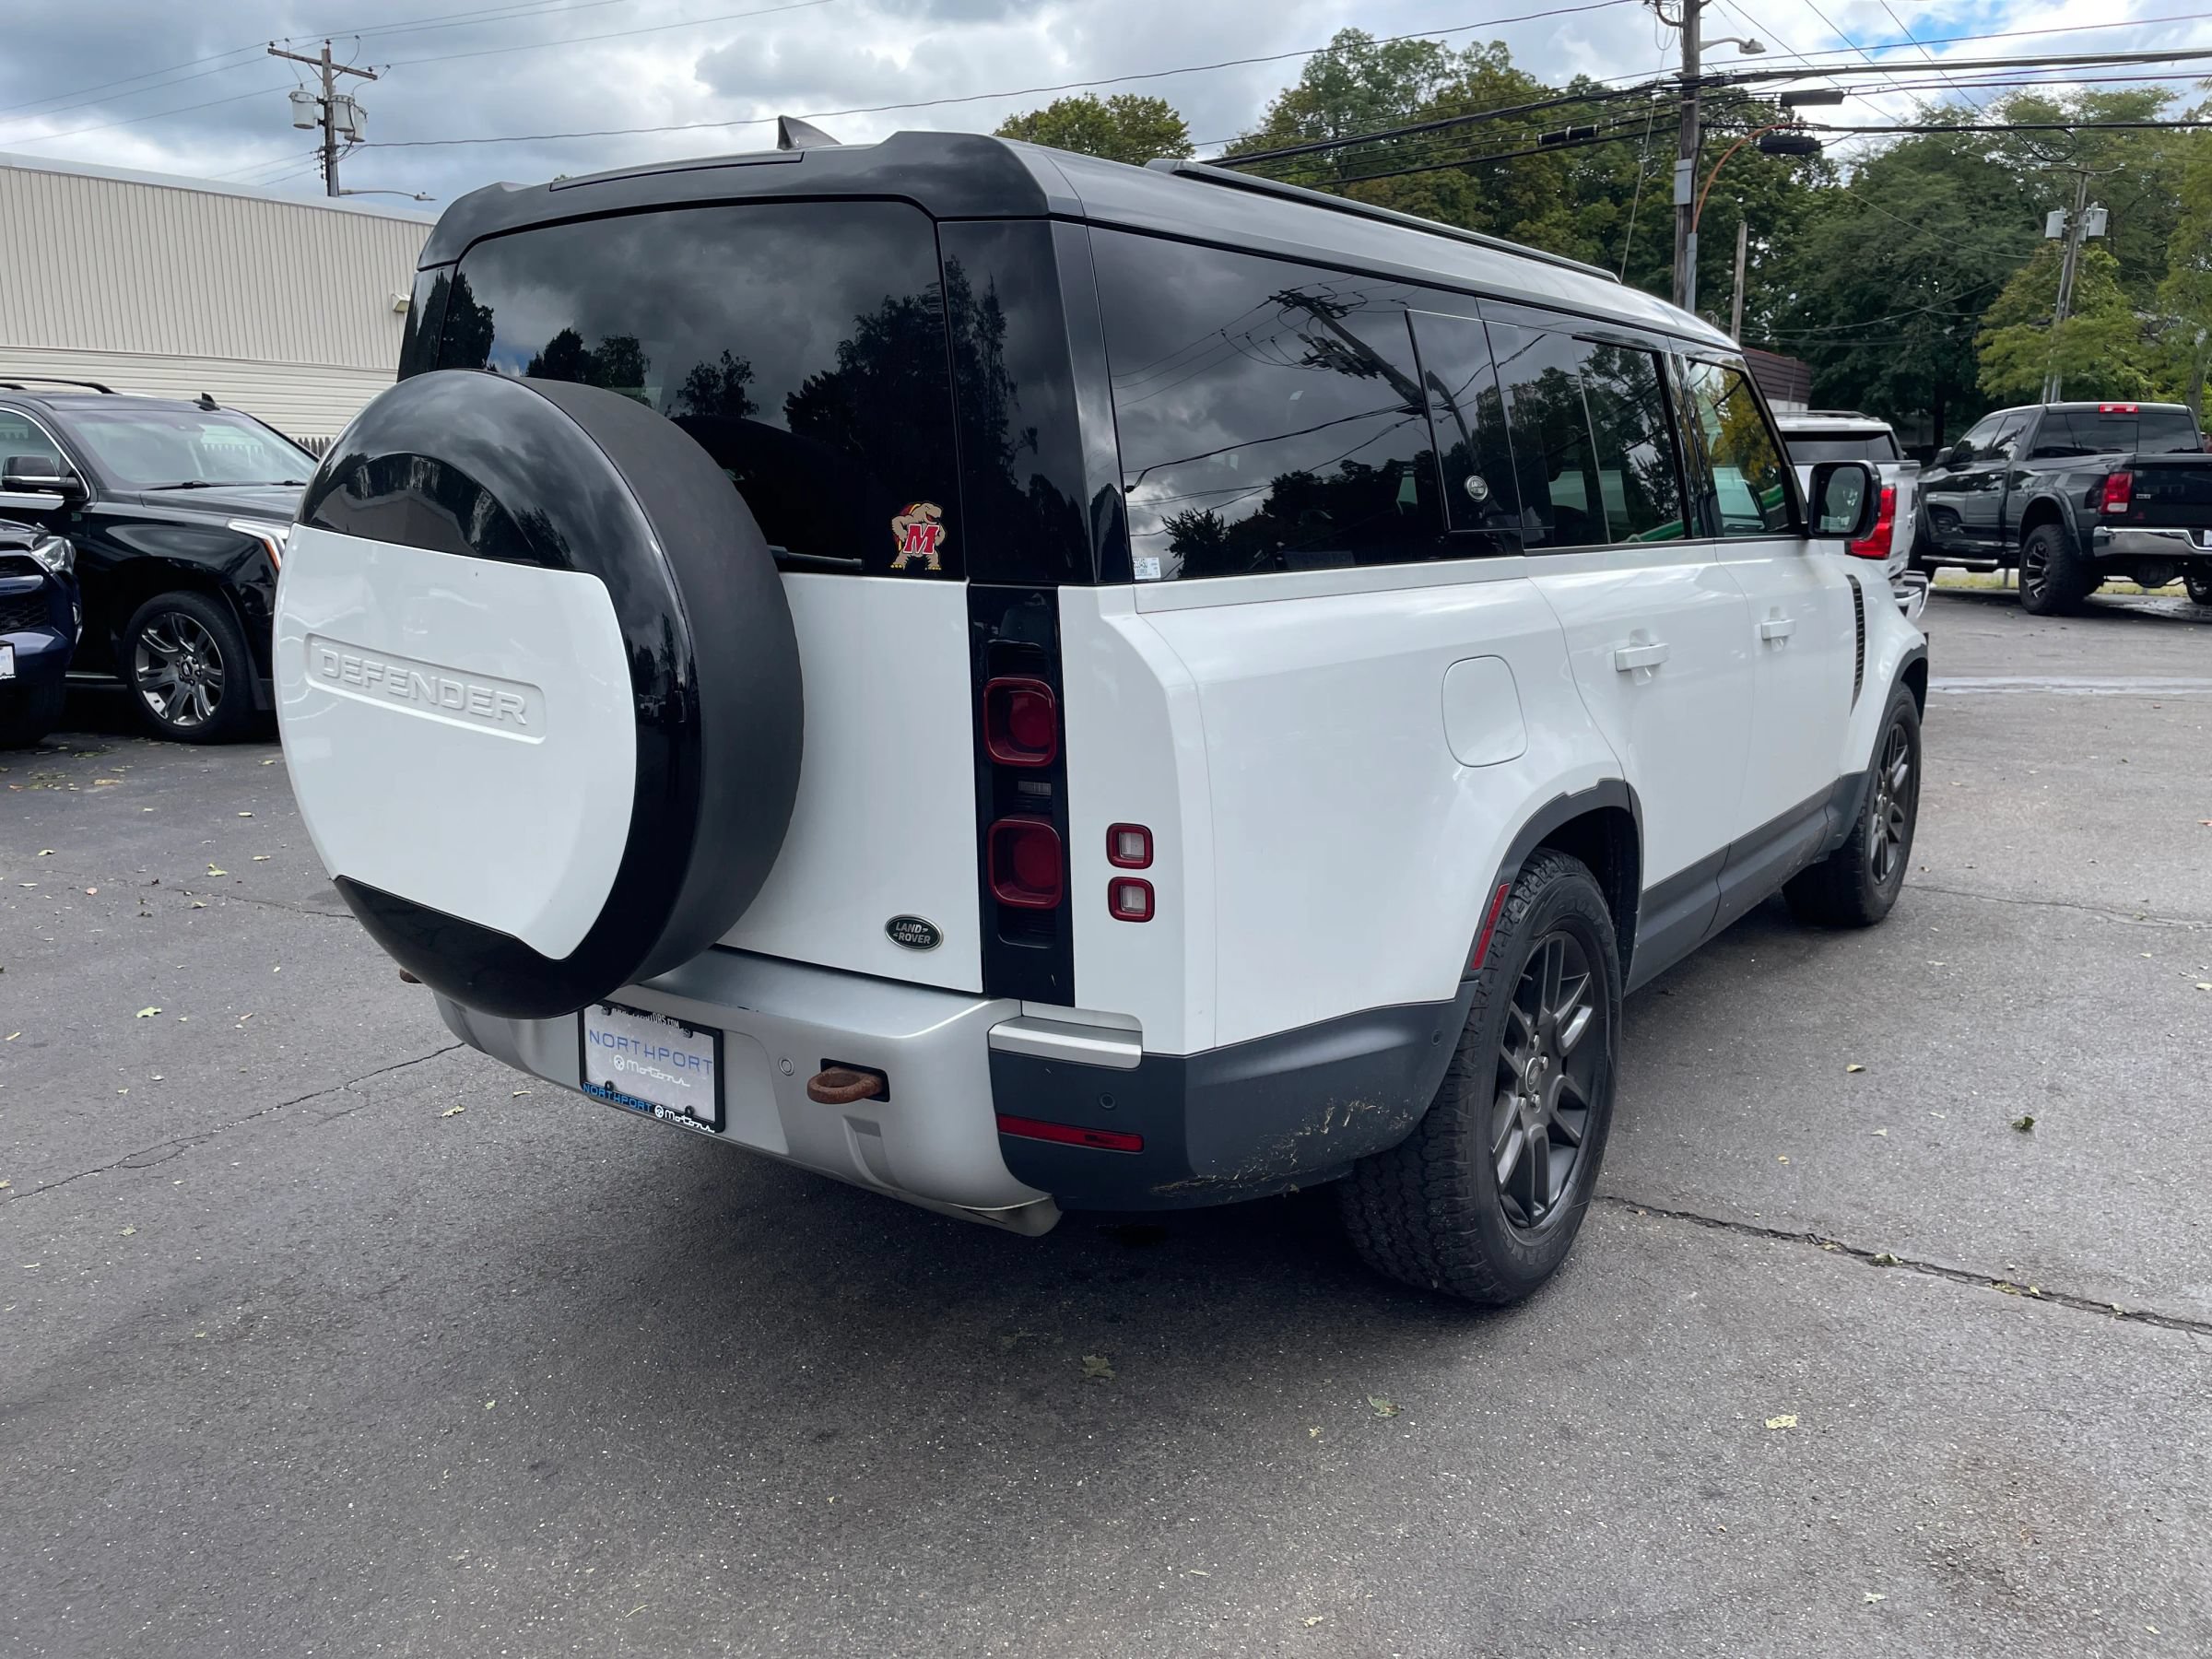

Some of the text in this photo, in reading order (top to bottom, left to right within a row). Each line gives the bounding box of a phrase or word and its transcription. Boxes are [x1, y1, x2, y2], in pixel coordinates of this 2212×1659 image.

[903, 524, 939, 554] M
[320, 648, 526, 724] DEFENDER
[896, 922, 922, 933] LAND
[898, 933, 931, 944] ROVER
[589, 1030, 712, 1075] NORTHPORT
[582, 1083, 653, 1112] NORTHPORT
